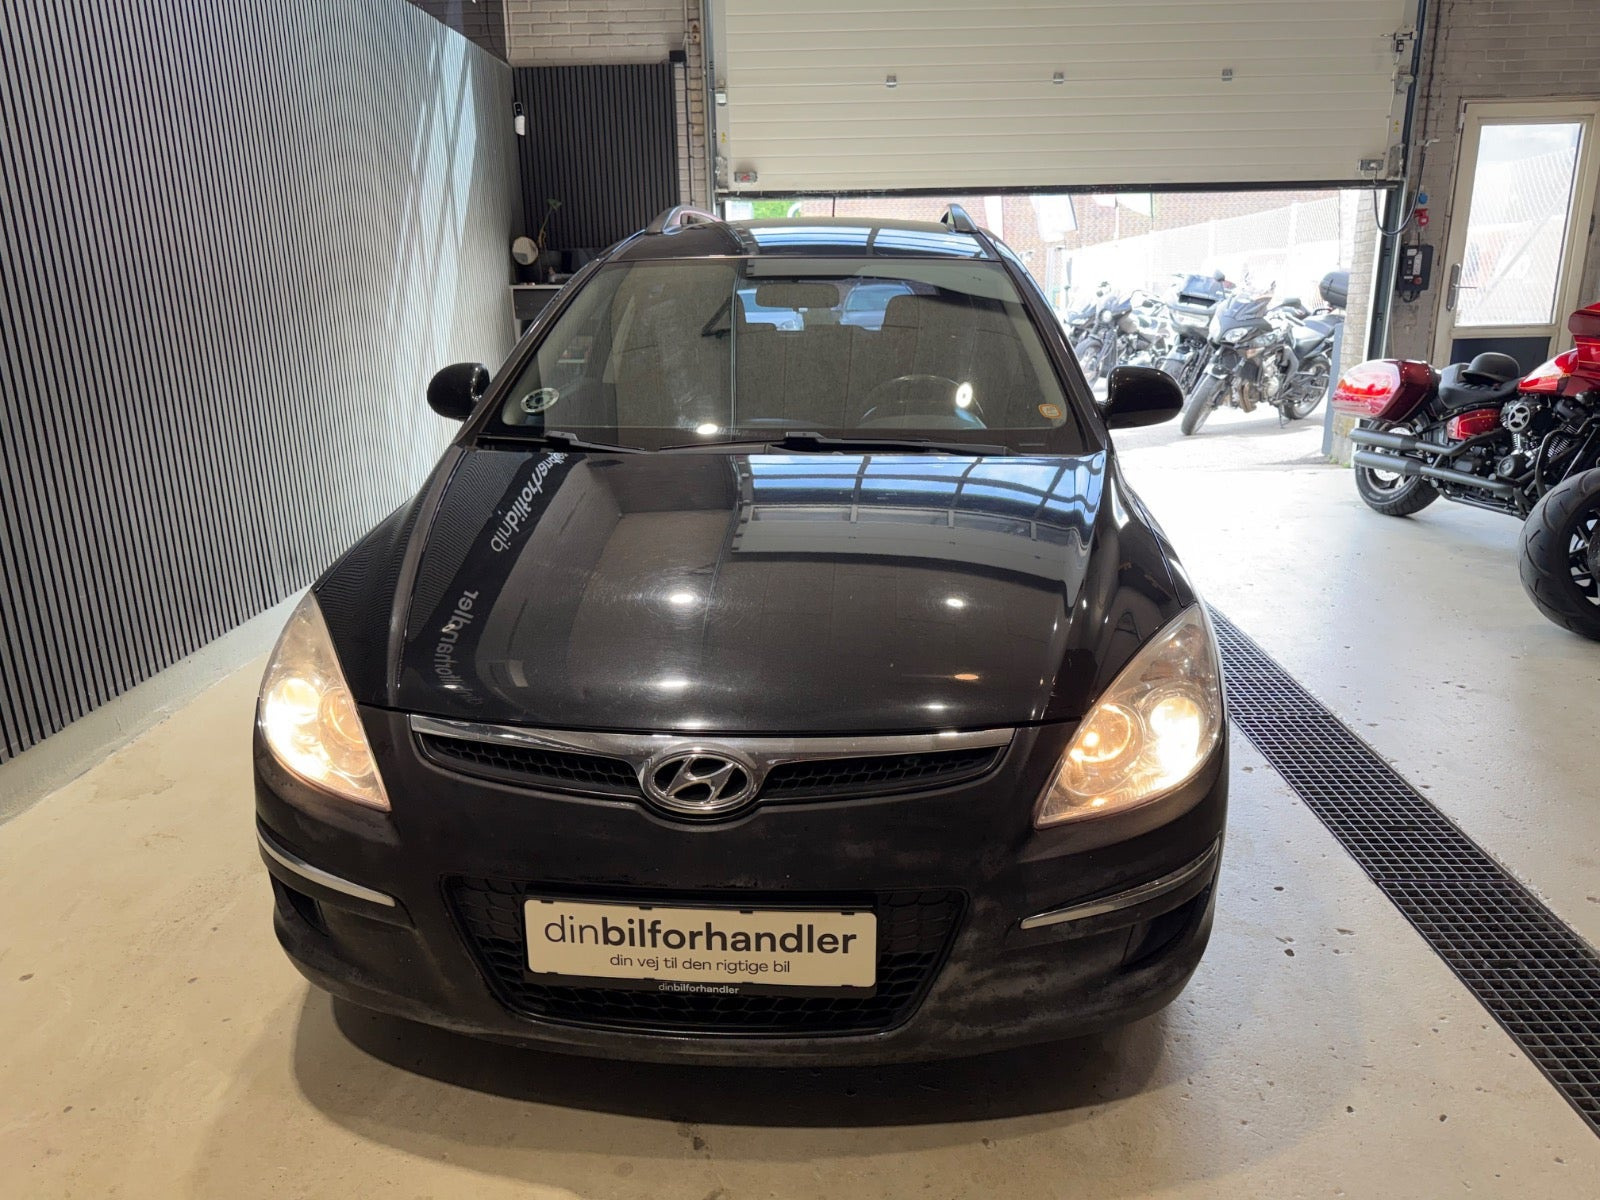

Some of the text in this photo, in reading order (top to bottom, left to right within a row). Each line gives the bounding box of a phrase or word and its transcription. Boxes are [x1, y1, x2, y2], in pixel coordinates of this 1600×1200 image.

[544, 914, 857, 954] dinbilforhandler
[609, 954, 791, 975] din vej til den rigtige bil
[658, 982, 740, 995] dinbilforhandler
